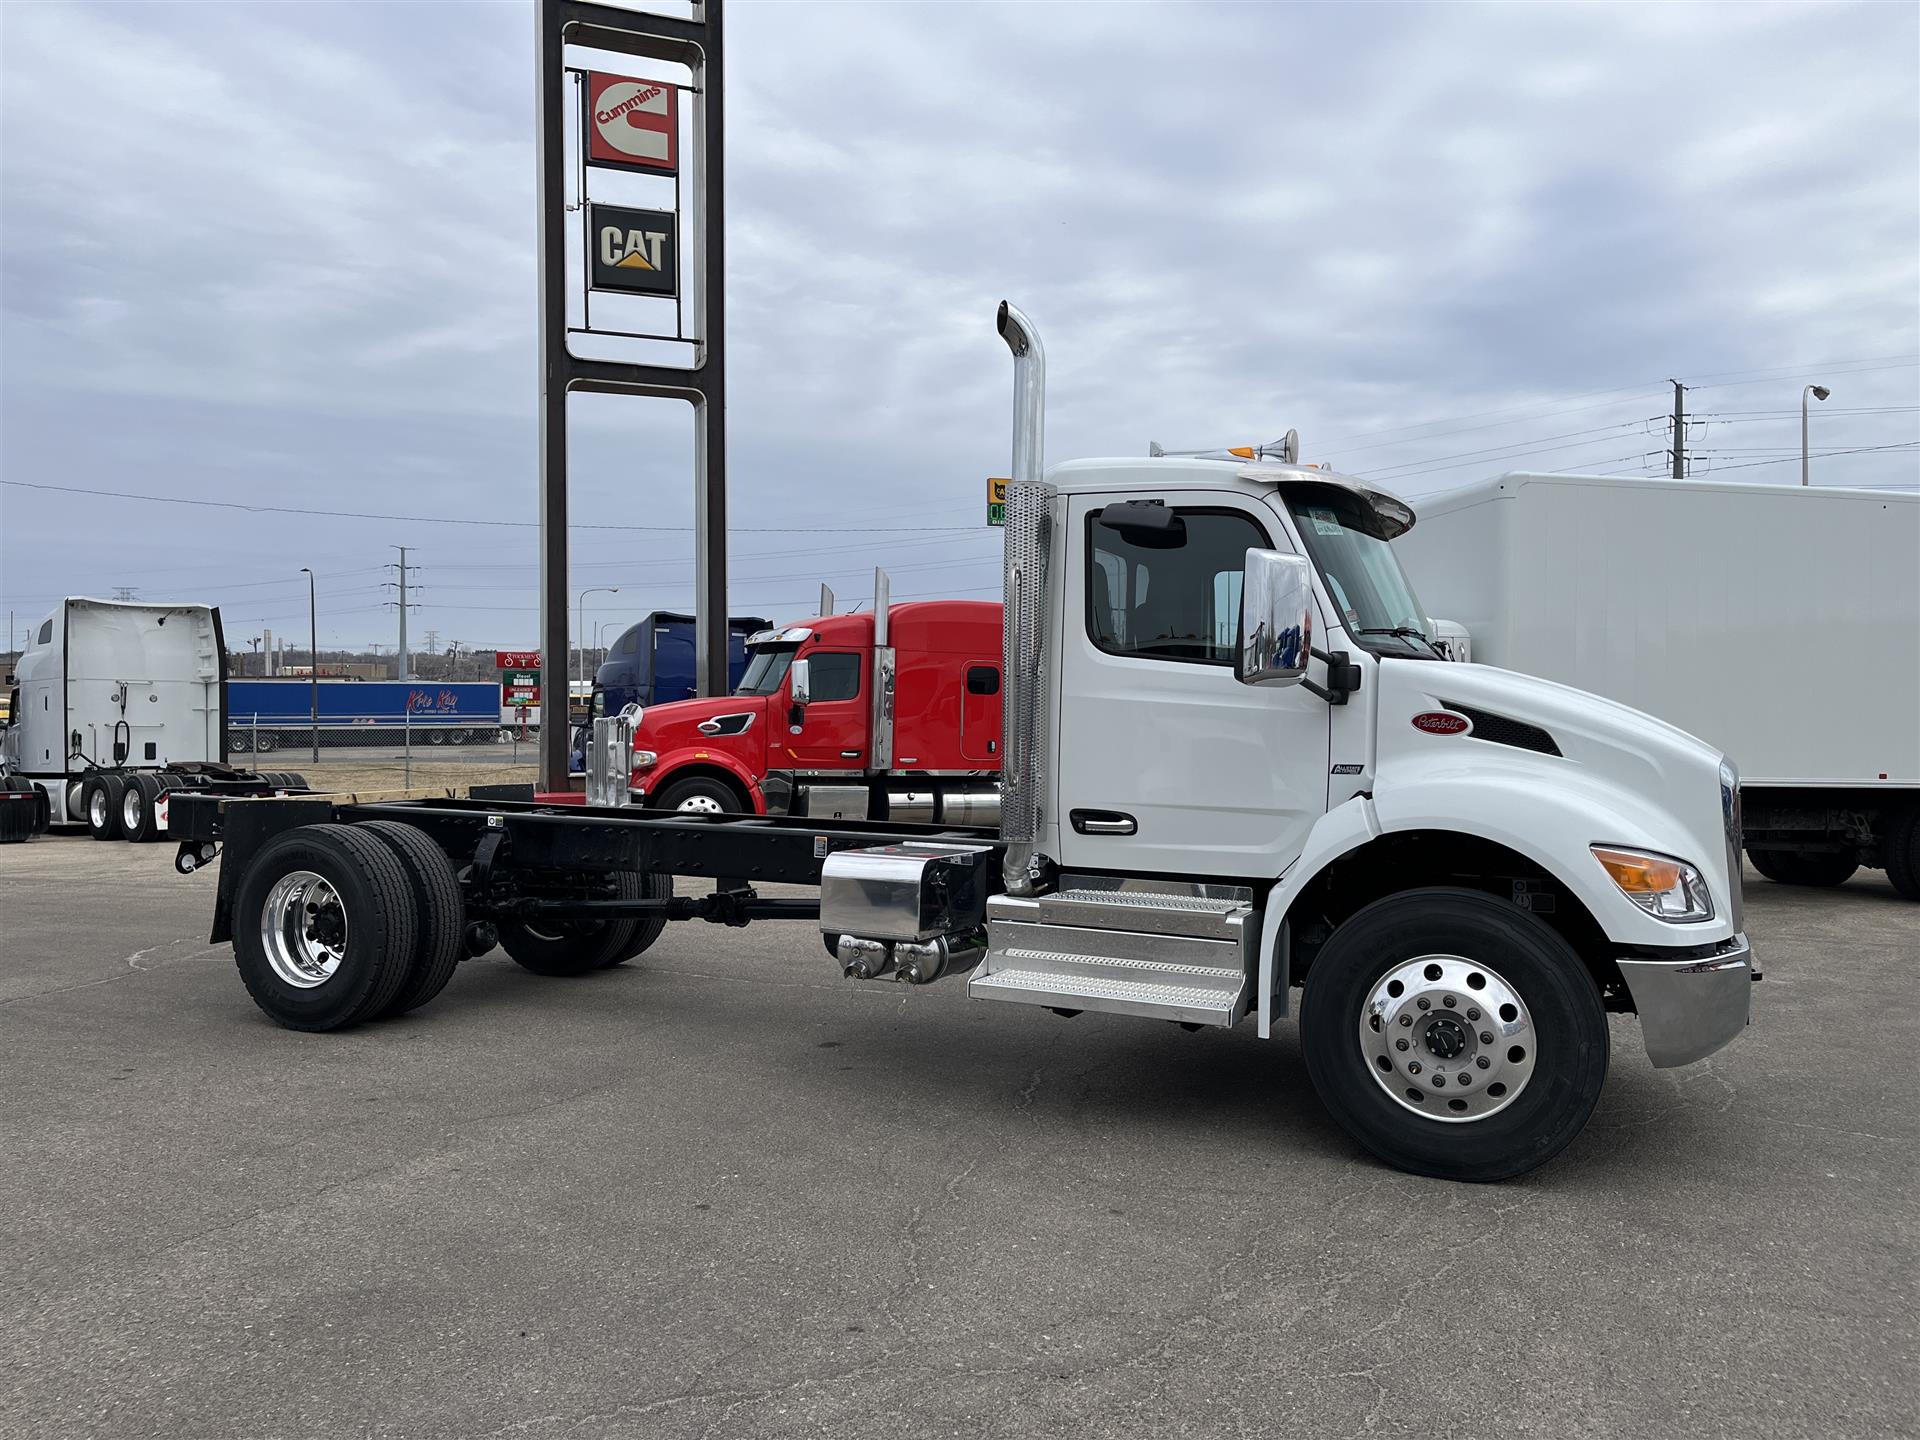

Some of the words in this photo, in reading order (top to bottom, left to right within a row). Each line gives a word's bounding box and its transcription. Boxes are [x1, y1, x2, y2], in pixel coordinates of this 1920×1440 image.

[596, 85, 661, 125] Cummins
[600, 225, 666, 272] CAT
[996, 488, 1005, 496] CA
[1417, 715, 1464, 731] Peterbilt
